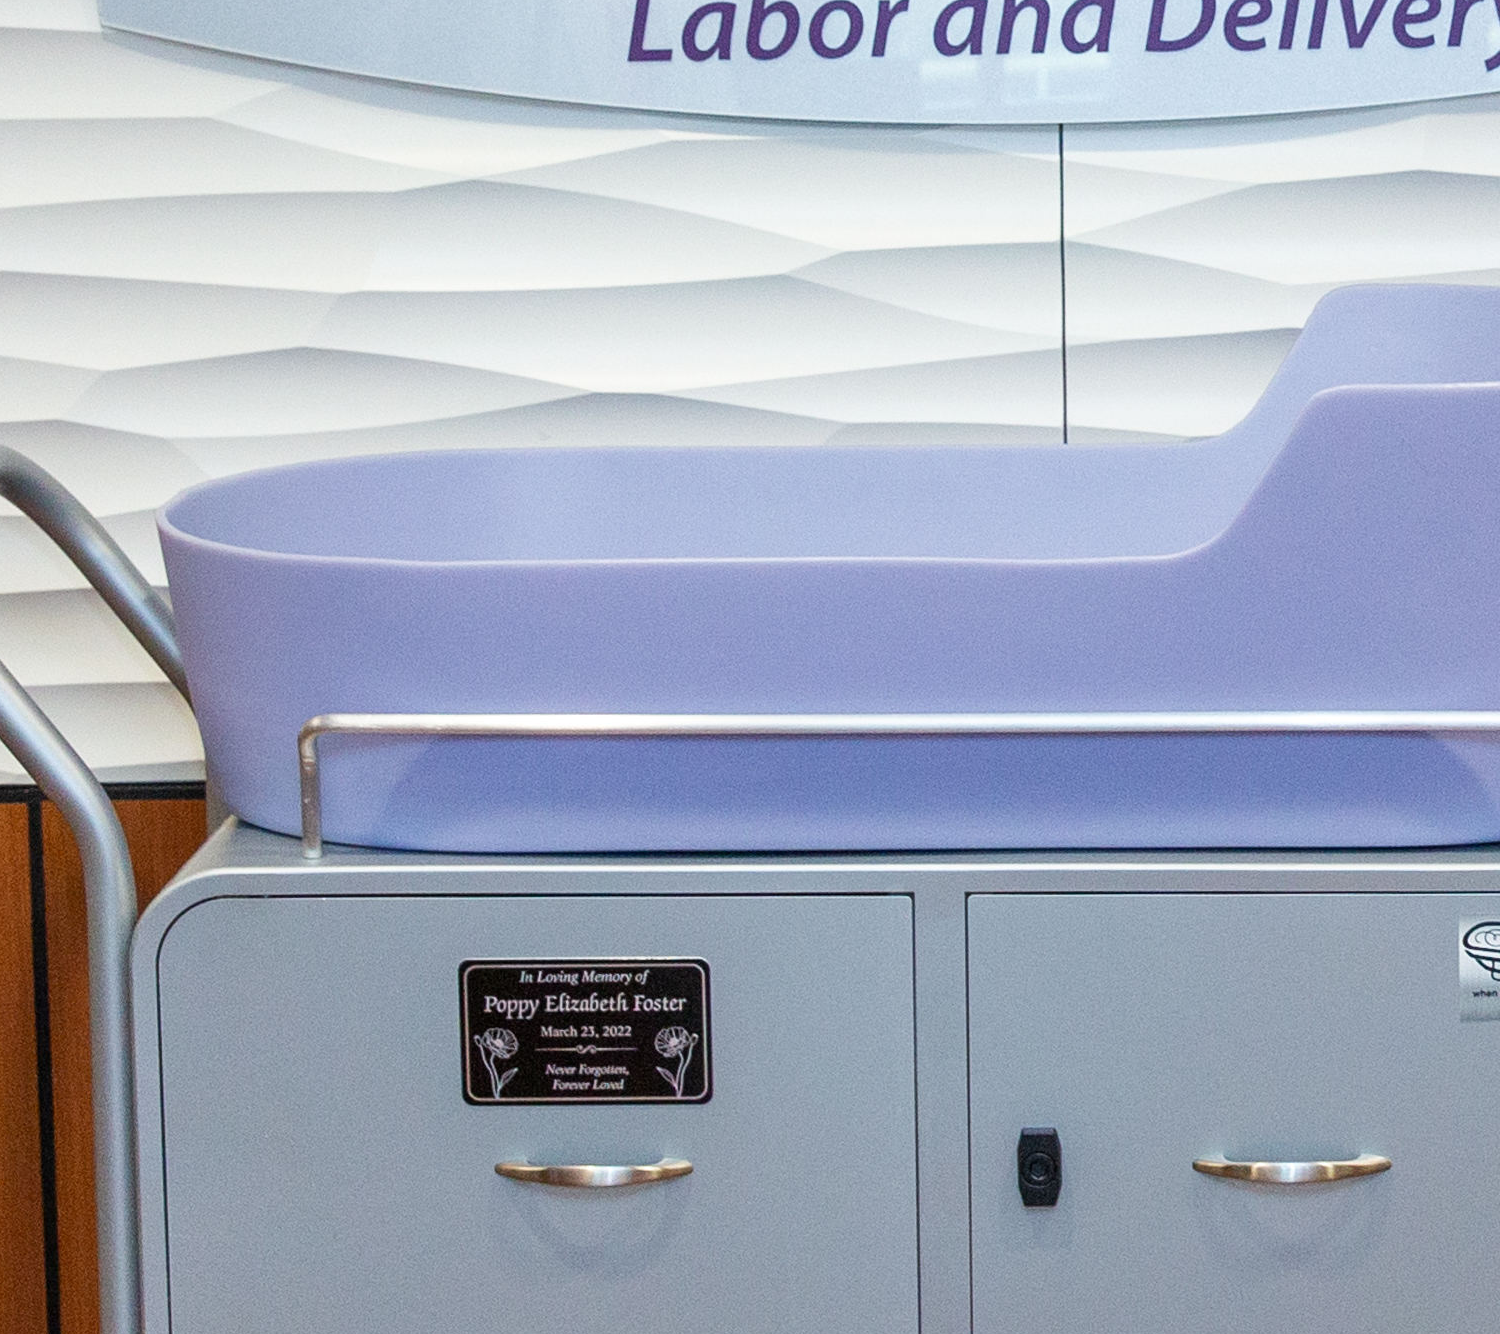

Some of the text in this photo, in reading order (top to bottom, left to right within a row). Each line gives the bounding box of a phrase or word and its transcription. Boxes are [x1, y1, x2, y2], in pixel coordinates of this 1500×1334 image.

[519, 970, 649, 985] In Loving Memory of
[1473, 990, 1498, 998] when
[484, 992, 687, 1019] Poppy Elizabeth Foster
[541, 1026, 632, 1038] March 23, 2022
[545, 1064, 629, 1077] Never Forgotten,
[552, 1079, 624, 1091] Forever Loved
